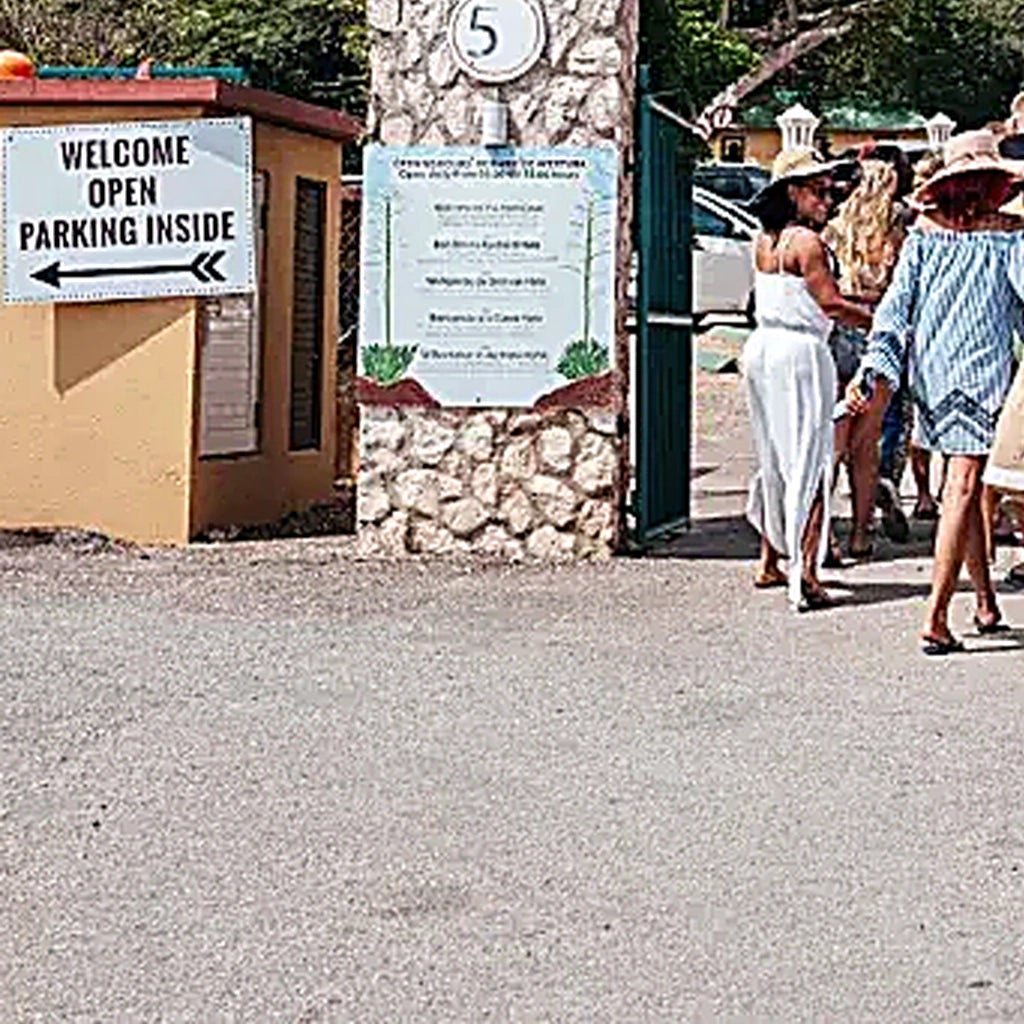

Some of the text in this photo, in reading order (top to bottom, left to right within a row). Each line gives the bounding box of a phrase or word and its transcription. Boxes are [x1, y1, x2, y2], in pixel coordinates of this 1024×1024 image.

[466, 5, 498, 58] 5
[61, 135, 191, 171] WELCOME
[87, 175, 157, 209] OPEN
[19, 211, 236, 251] PARKING INSIDE
